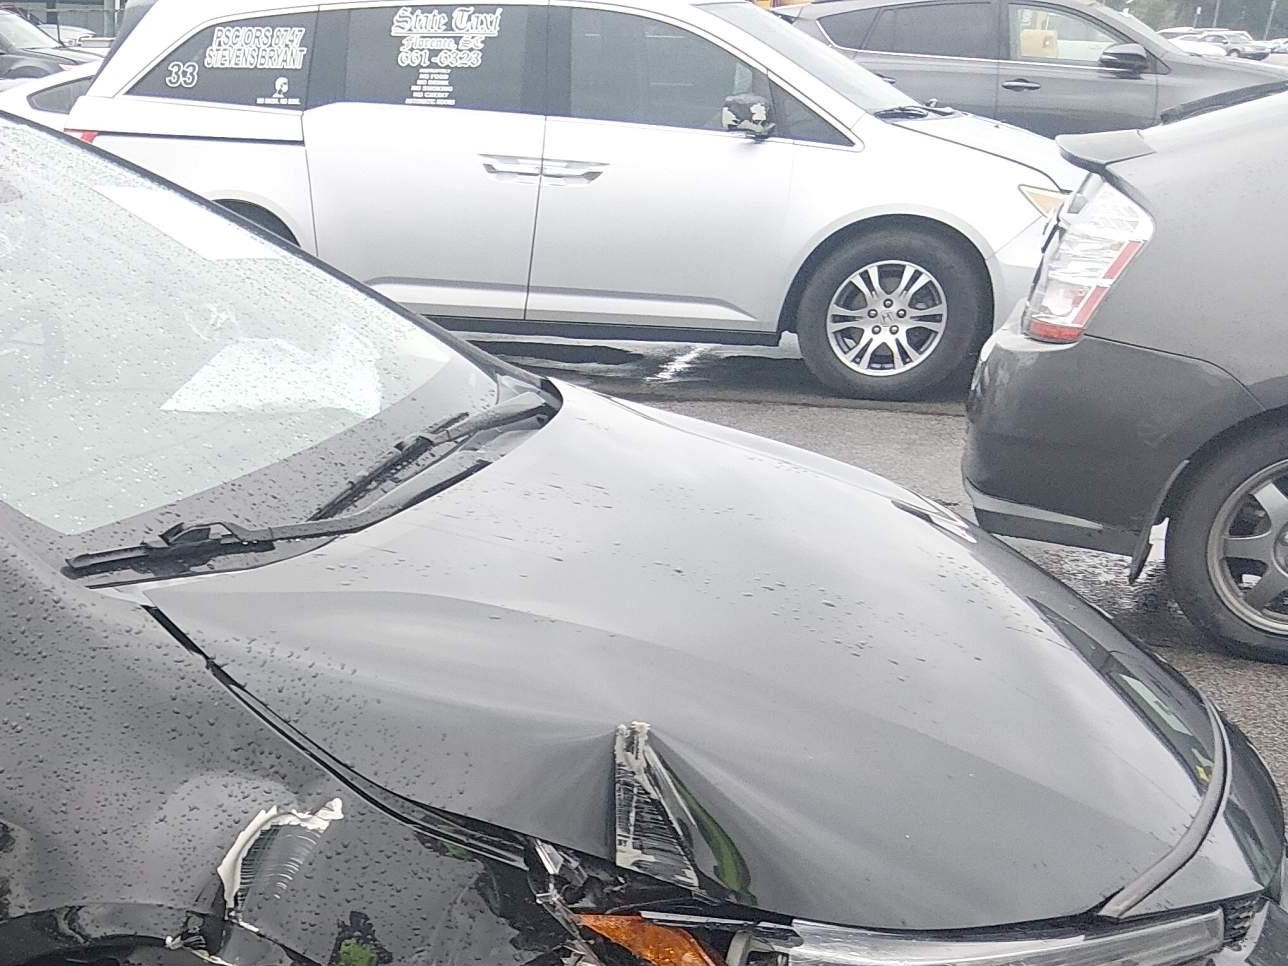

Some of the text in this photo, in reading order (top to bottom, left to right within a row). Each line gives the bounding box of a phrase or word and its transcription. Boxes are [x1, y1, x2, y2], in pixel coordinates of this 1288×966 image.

[392, 7, 503, 33] State Taxi
[204, 47, 307, 69] STEVENS BRYANT
[165, 62, 199, 88] 33
